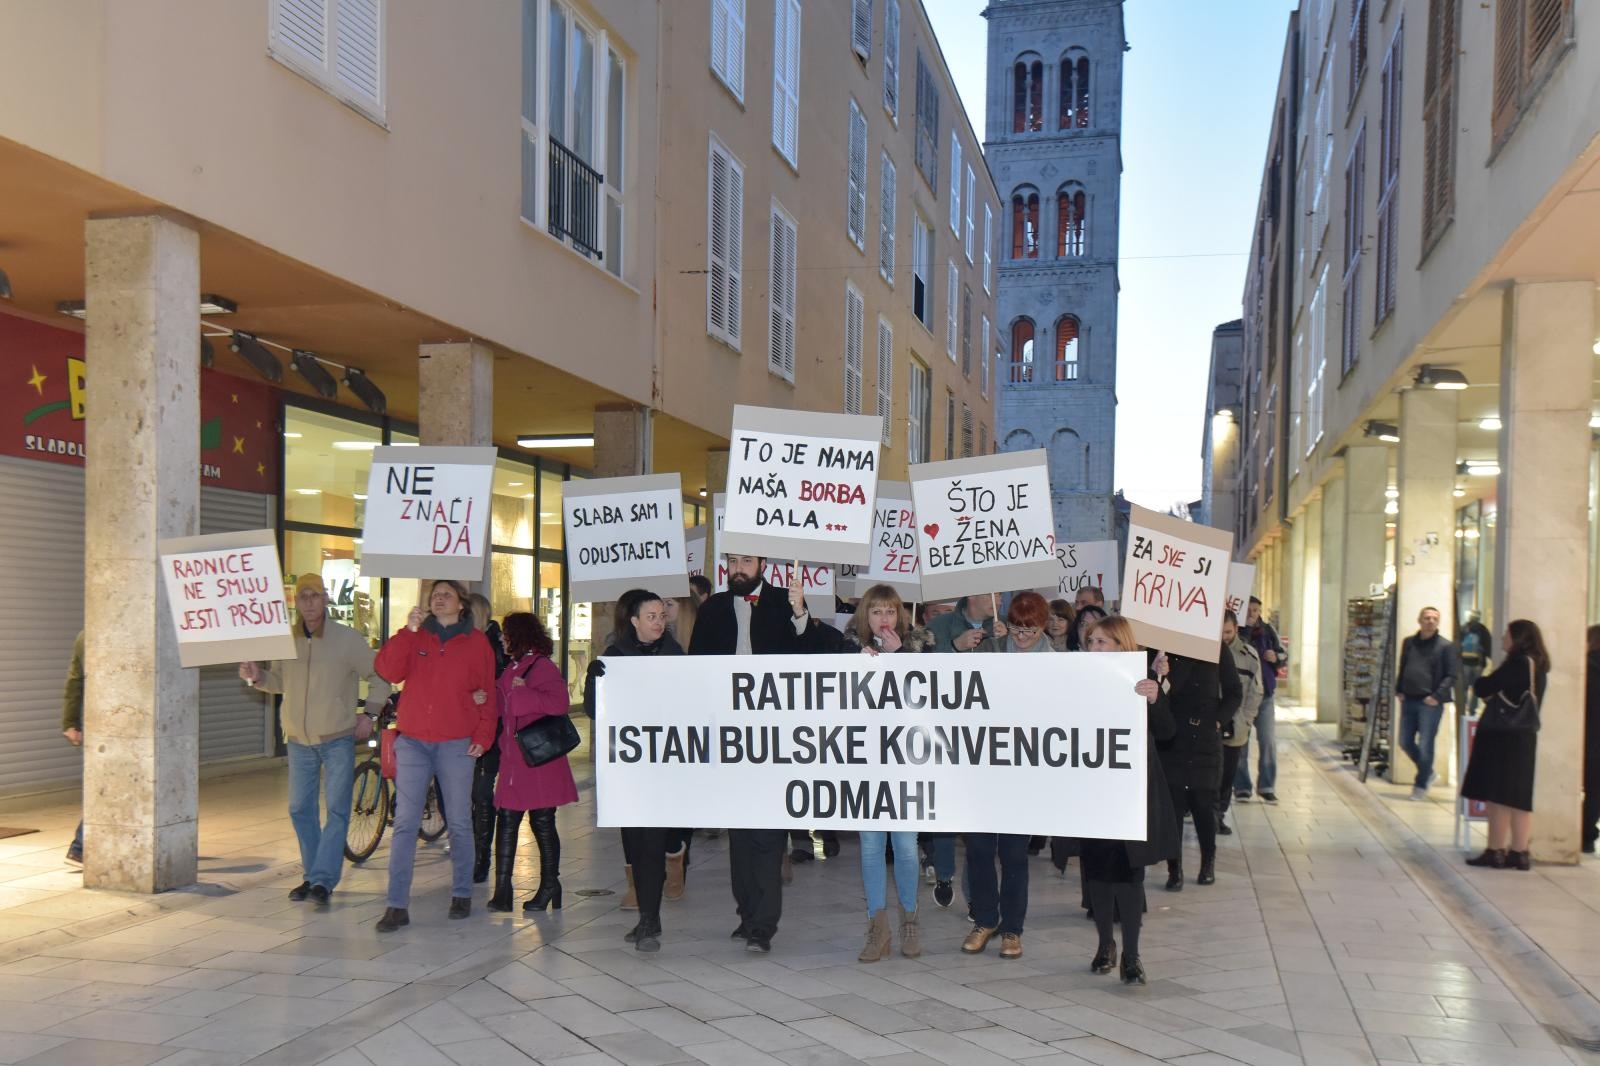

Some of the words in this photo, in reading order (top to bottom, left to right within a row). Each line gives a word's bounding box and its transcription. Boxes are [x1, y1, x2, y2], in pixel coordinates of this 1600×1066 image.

[25, 435, 86, 458] SLADOL
[740, 437, 773, 463] TO
[782, 443, 808, 465] JE
[817, 446, 875, 471] NAMA
[201, 464, 221, 479] AM
[386, 466, 435, 496] NE
[738, 473, 788, 499] NAŠA
[798, 480, 866, 505] BORBA
[947, 480, 995, 513] ŠTO
[1007, 483, 1029, 512] JE
[400, 496, 473, 524] ZNAČI
[573, 506, 624, 528] SLABA
[631, 503, 658, 522] SAM
[668, 502, 673, 520] I
[874, 509, 916, 528] NEPL
[432, 524, 472, 555] DA
[956, 516, 1020, 543] ŽENA
[173, 553, 254, 579] RADNICE
[579, 541, 671, 566] ODUSTAJEM
[929, 544, 965, 568] BEZ
[972, 534, 1055, 565] BRKOVA?
[1132, 535, 1153, 561] ZA
[1157, 545, 1187, 568] SVE
[1193, 557, 1212, 576] SI
[184, 582, 207, 600] NE
[216, 576, 269, 599] SMIJU
[1134, 569, 1209, 618] KRIVA
[180, 608, 221, 631] JESTI
[229, 598, 287, 628] PRŠUT!
[732, 670, 990, 711] RATIFIKACIJA
[880, 726, 1132, 770] KONVENCIJE
[785, 779, 937, 821] ODMAH!
